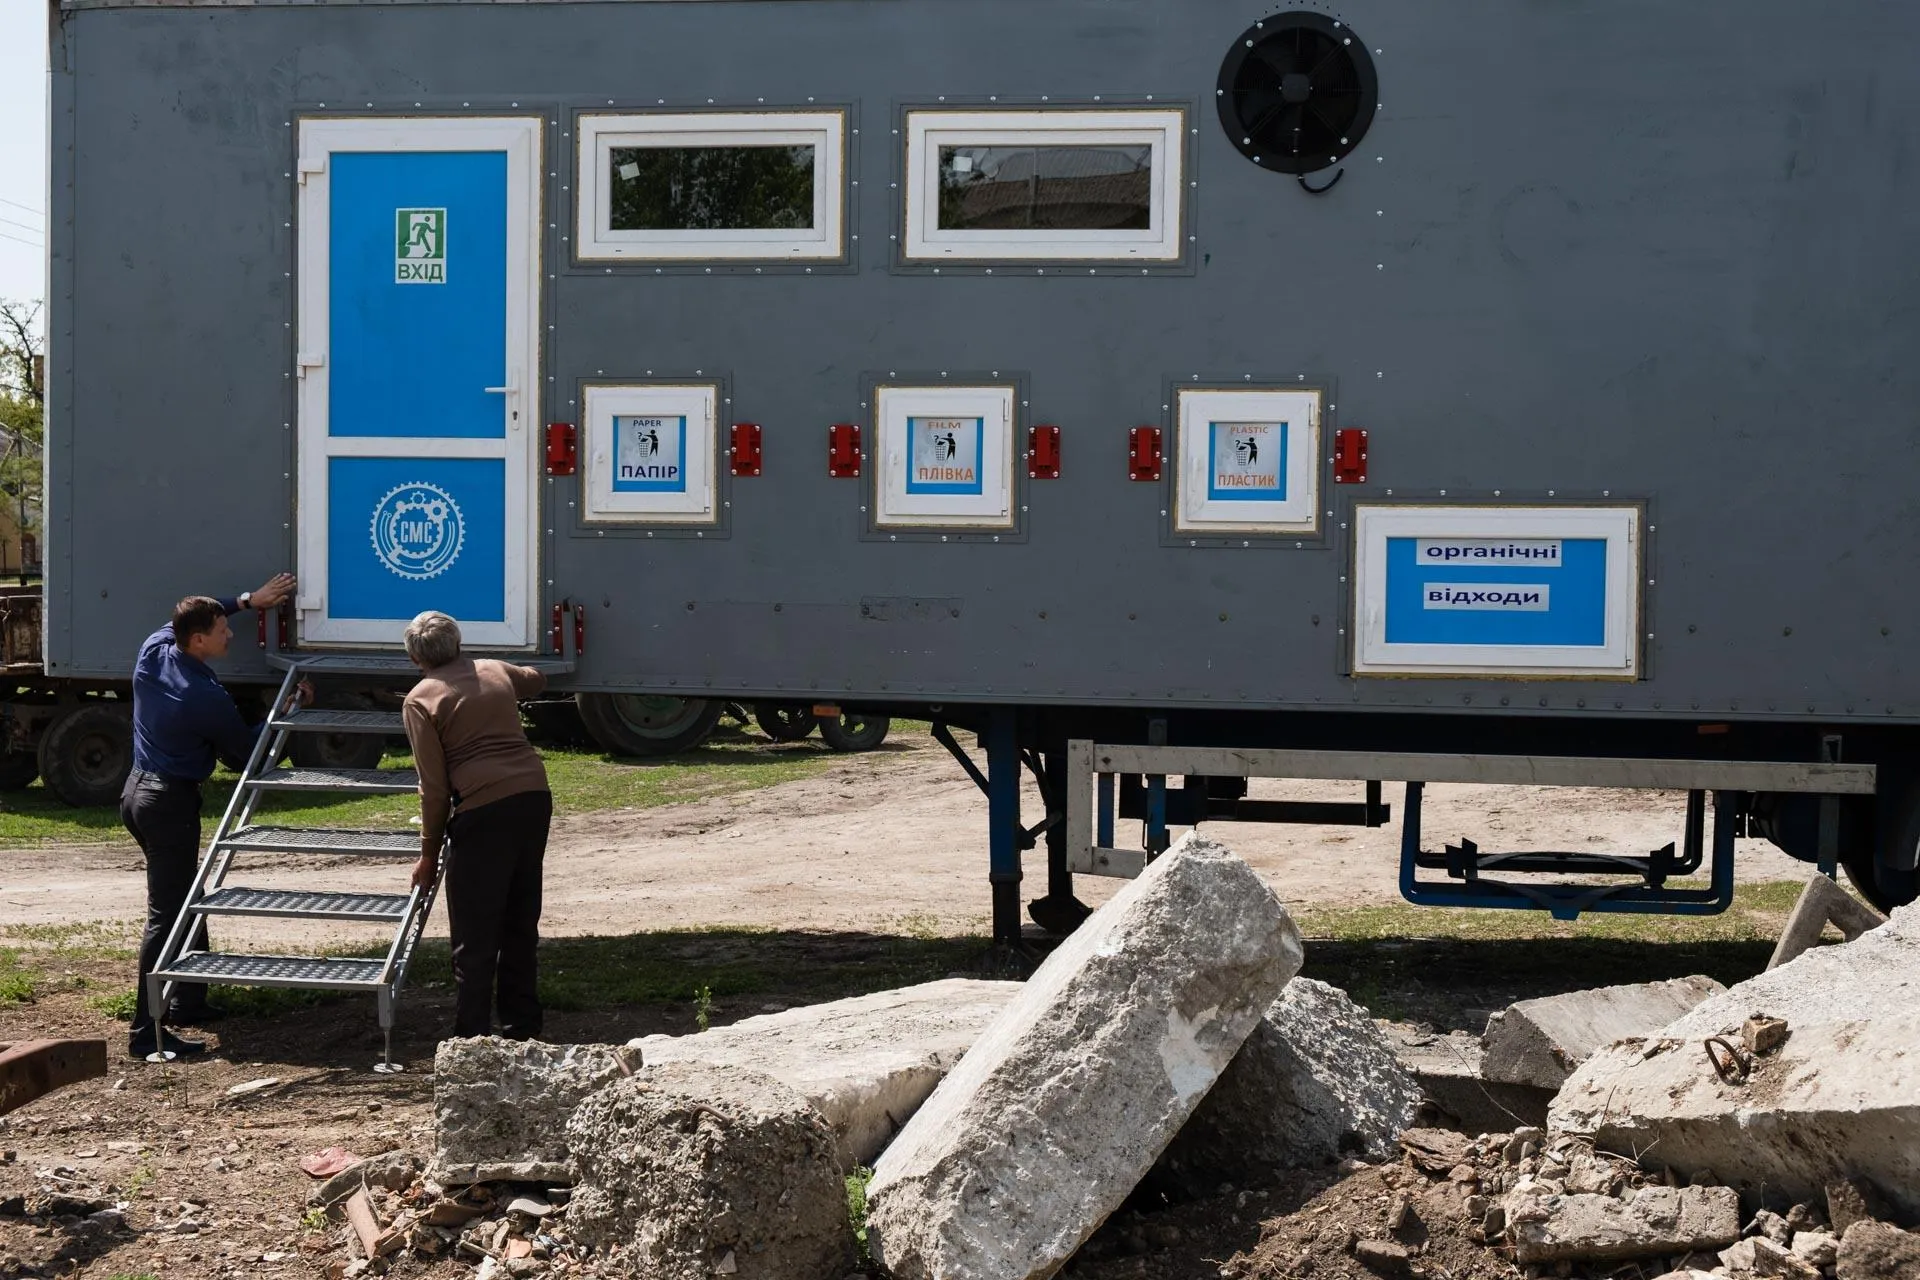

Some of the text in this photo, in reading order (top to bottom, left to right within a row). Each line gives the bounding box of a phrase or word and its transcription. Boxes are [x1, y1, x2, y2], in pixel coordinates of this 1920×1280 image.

[398, 264, 443, 282] ВХІД
[633, 419, 662, 427] PAPER
[928, 421, 961, 429] FILM
[1230, 426, 1269, 434] PLASTIC
[621, 465, 678, 478] ПАПІР
[919, 467, 974, 481] ПЛІВКА
[1218, 474, 1275, 486] ПЛАСТИК
[1426, 544, 1557, 560] органічні
[1428, 588, 1539, 605] відходи
